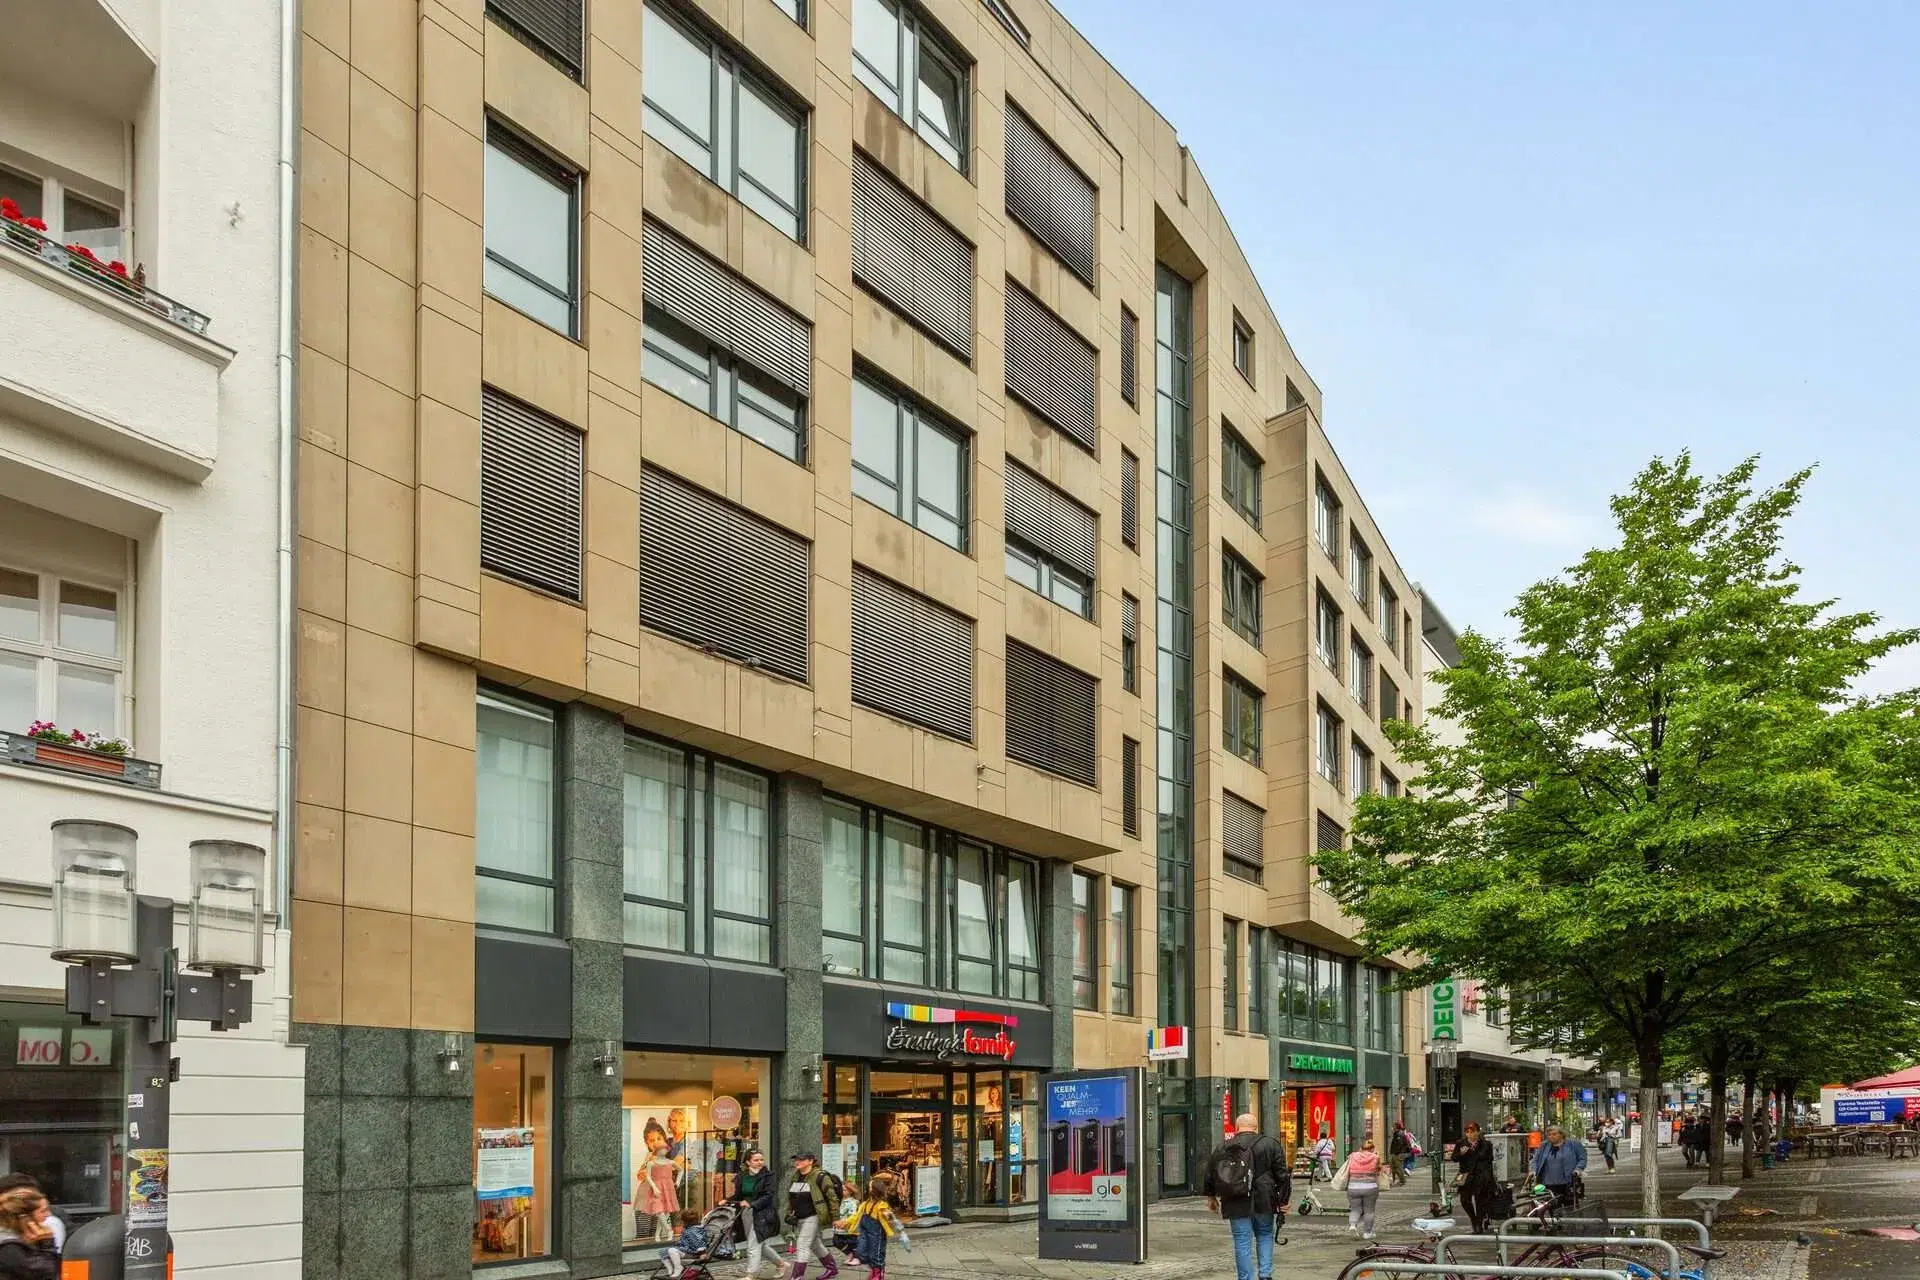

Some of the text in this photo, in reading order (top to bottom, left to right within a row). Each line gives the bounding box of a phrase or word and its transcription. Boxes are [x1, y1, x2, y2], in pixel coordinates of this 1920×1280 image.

[963, 1028, 1017, 1061] family
[1054, 1085, 1076, 1093] KEEN
[1069, 1107, 1098, 1116] MEHR?
[1096, 1179, 1121, 1199] glo
